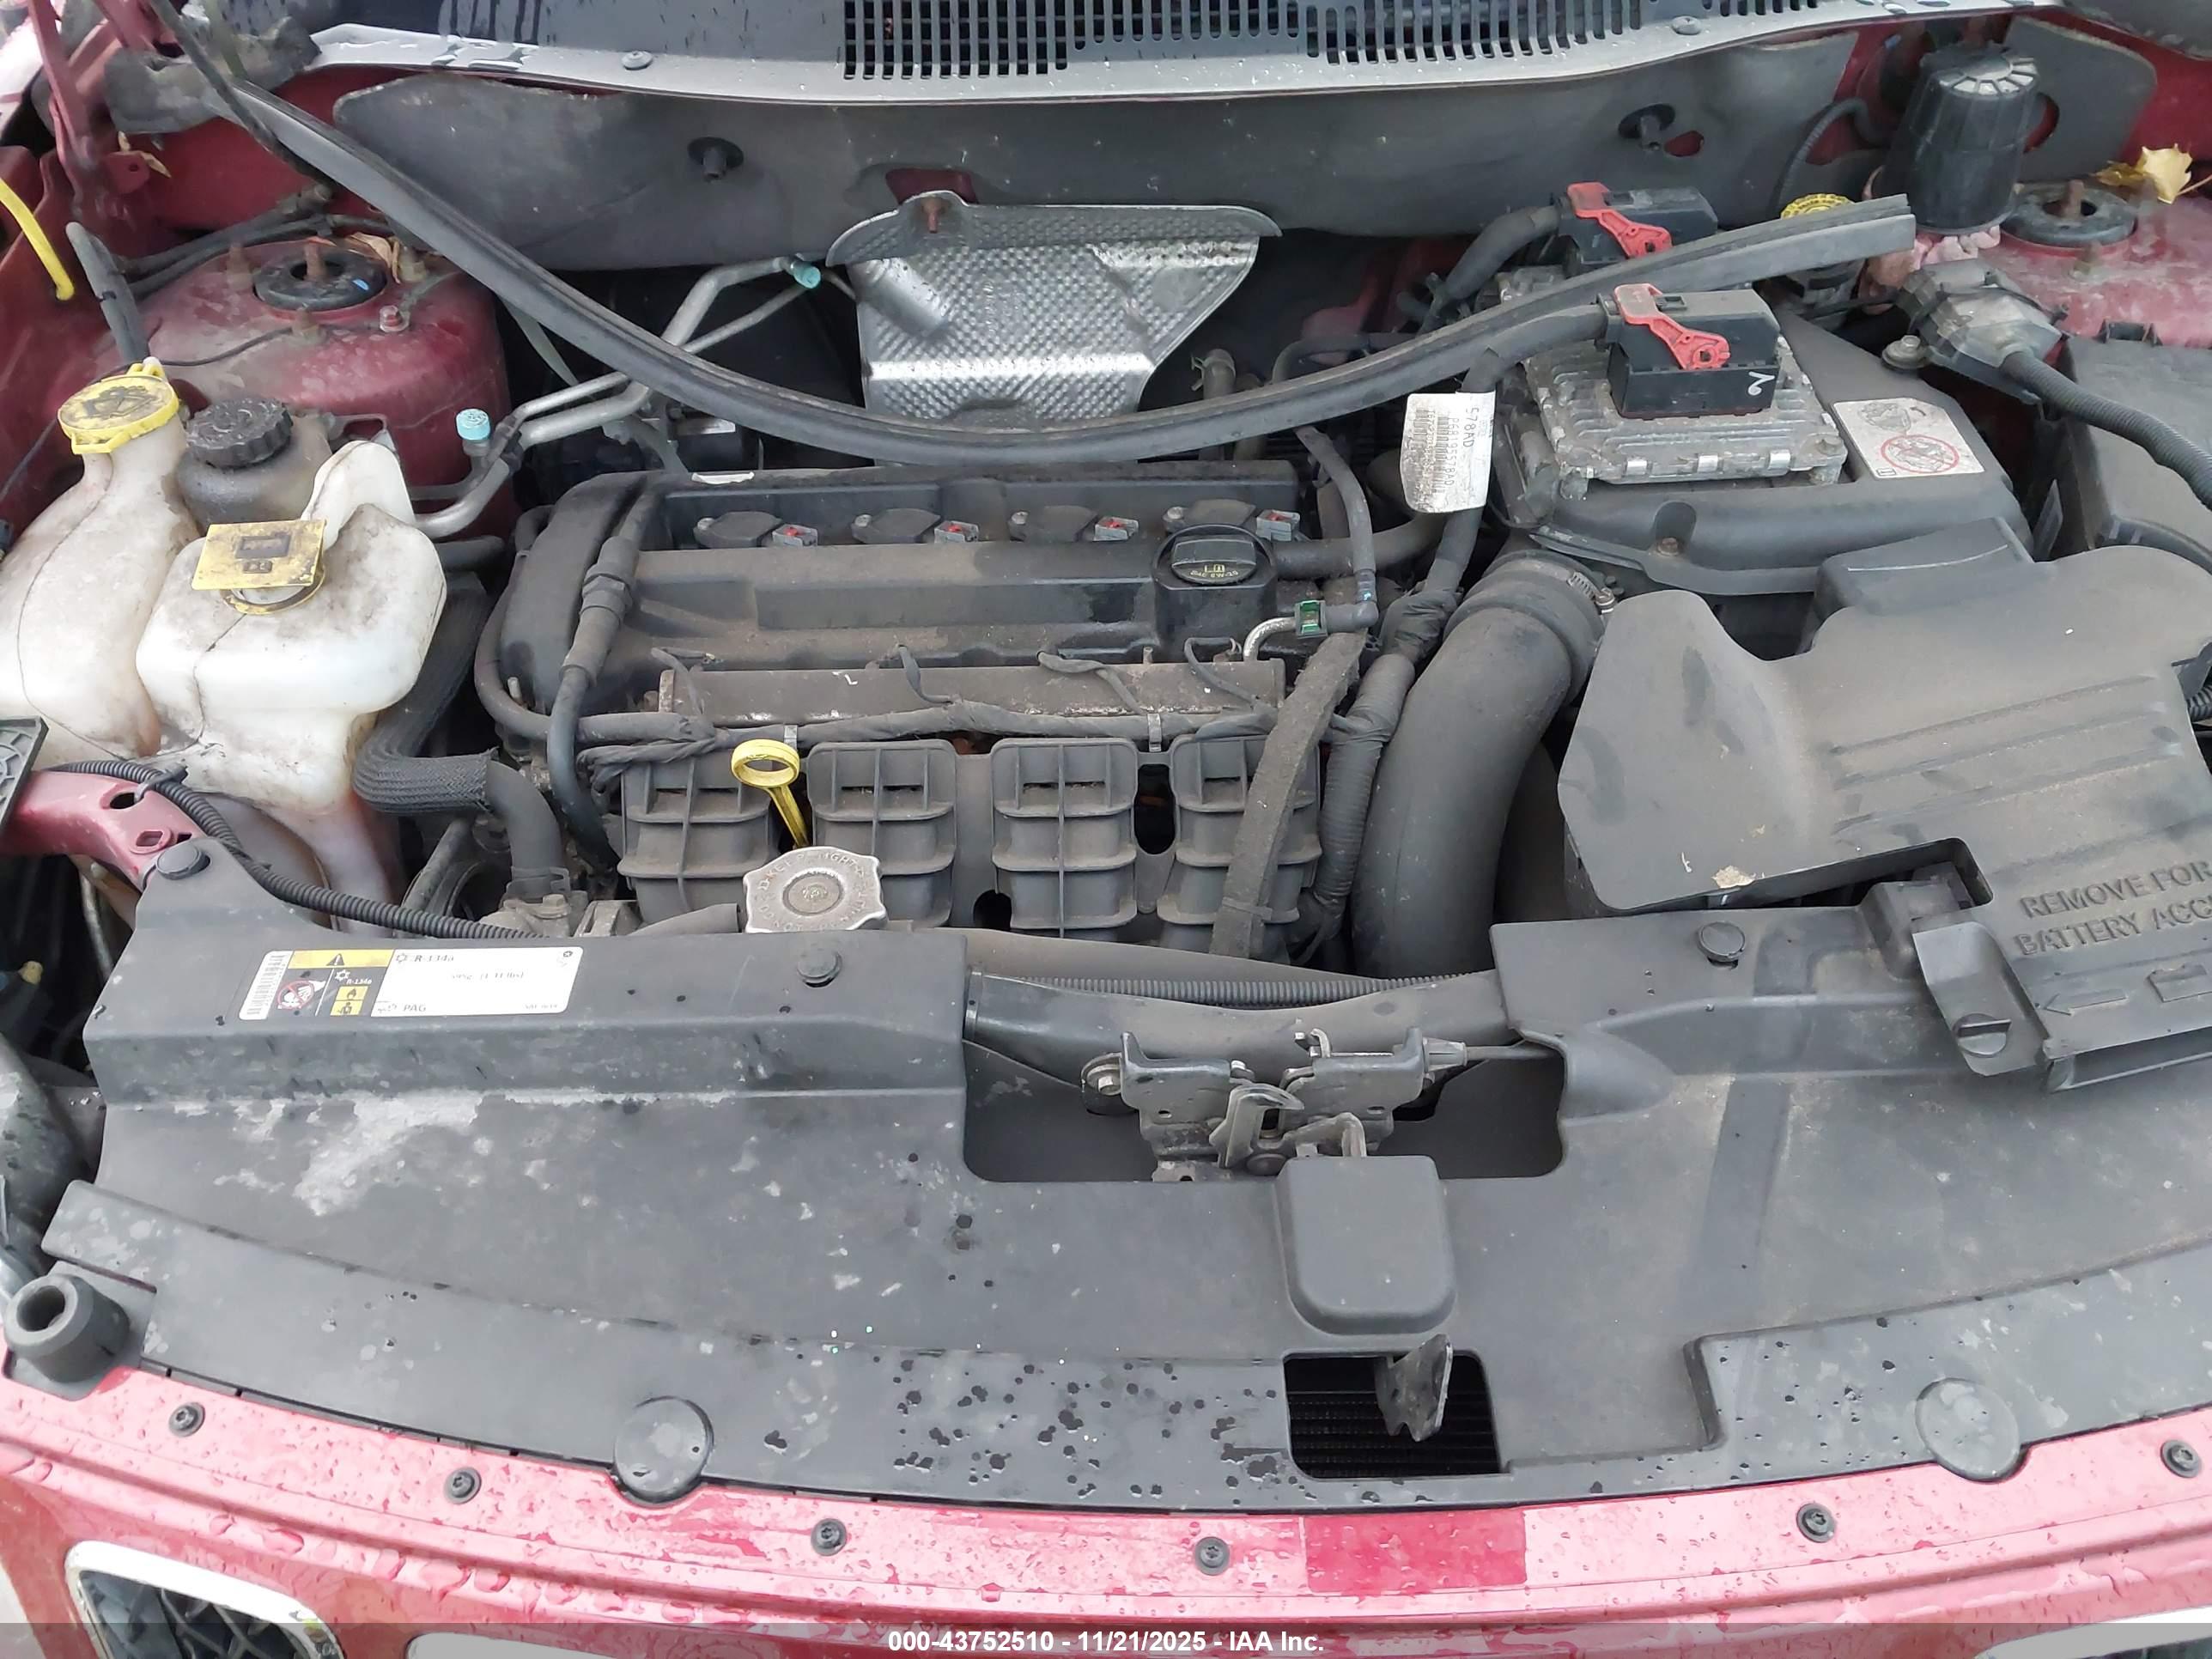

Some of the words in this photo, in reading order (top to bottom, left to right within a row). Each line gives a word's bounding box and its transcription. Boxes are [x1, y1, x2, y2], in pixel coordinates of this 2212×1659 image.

[2019, 874, 2150, 919] REMOVE
[2014, 912, 2141, 956] BATTERY
[2151, 895, 2212, 930] ACC
[404, 1004, 427, 1012] PAG
